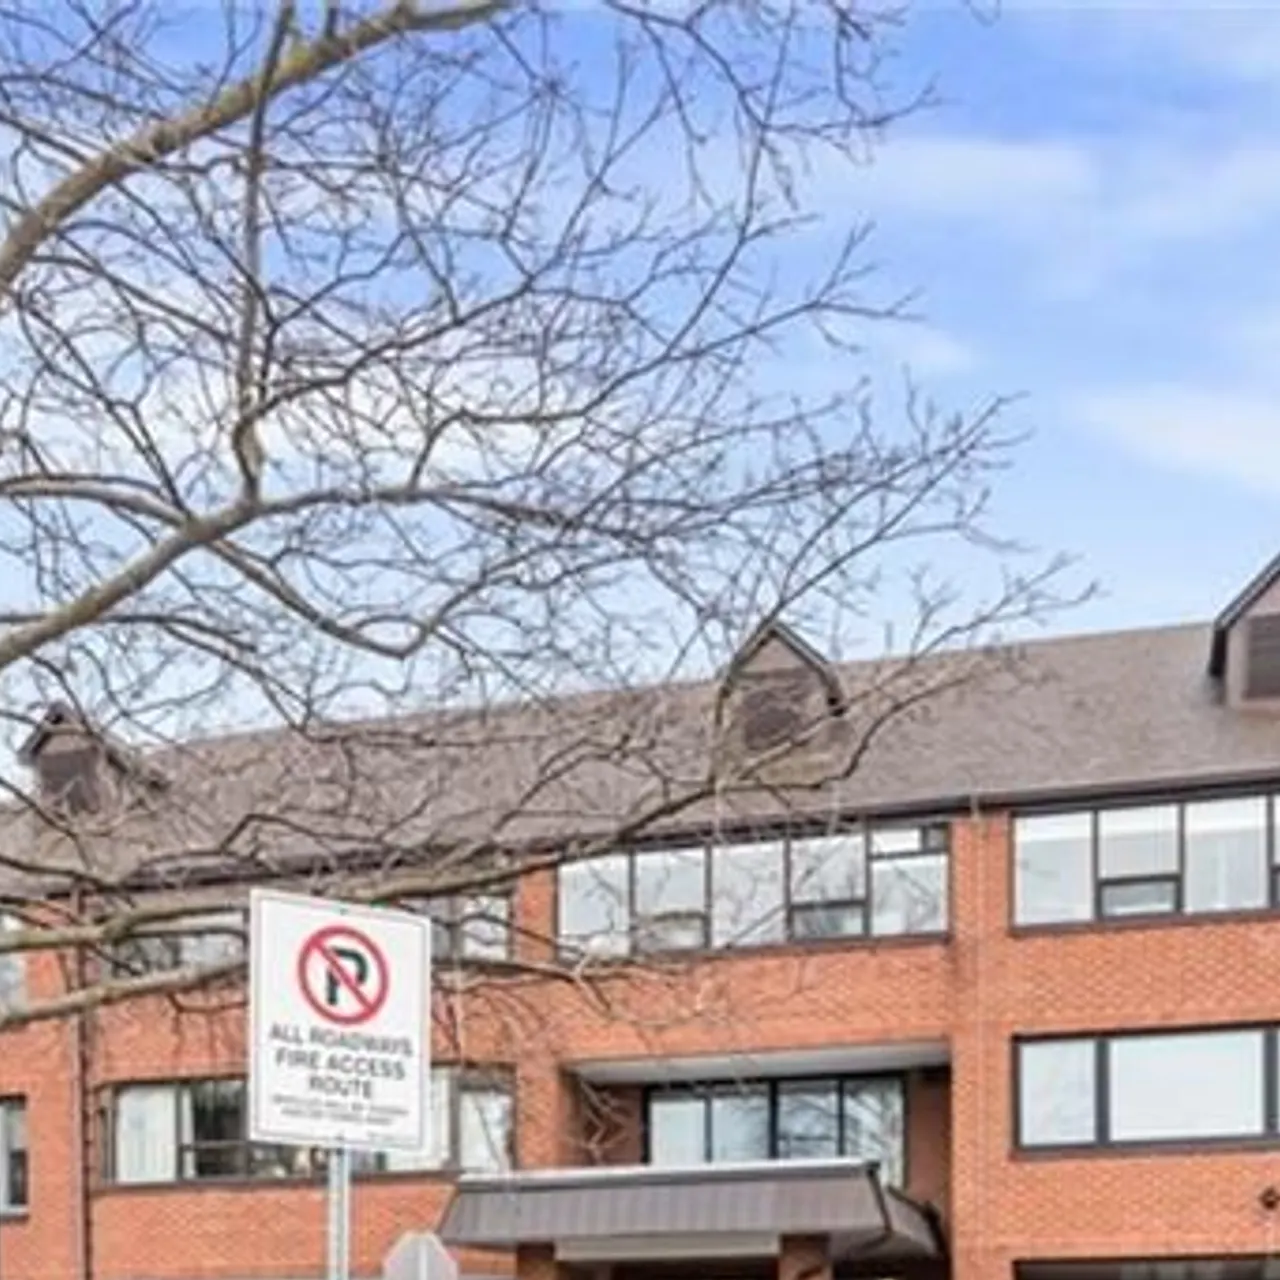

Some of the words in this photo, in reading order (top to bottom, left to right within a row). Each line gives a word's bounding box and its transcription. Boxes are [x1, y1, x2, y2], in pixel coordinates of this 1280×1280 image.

[269, 1022, 304, 1045] ALL
[309, 1026, 414, 1058] ROADWAYS
[275, 1046, 320, 1069] FIRE
[326, 1053, 406, 1081] ACCESS
[309, 1075, 373, 1099] ROUTE
